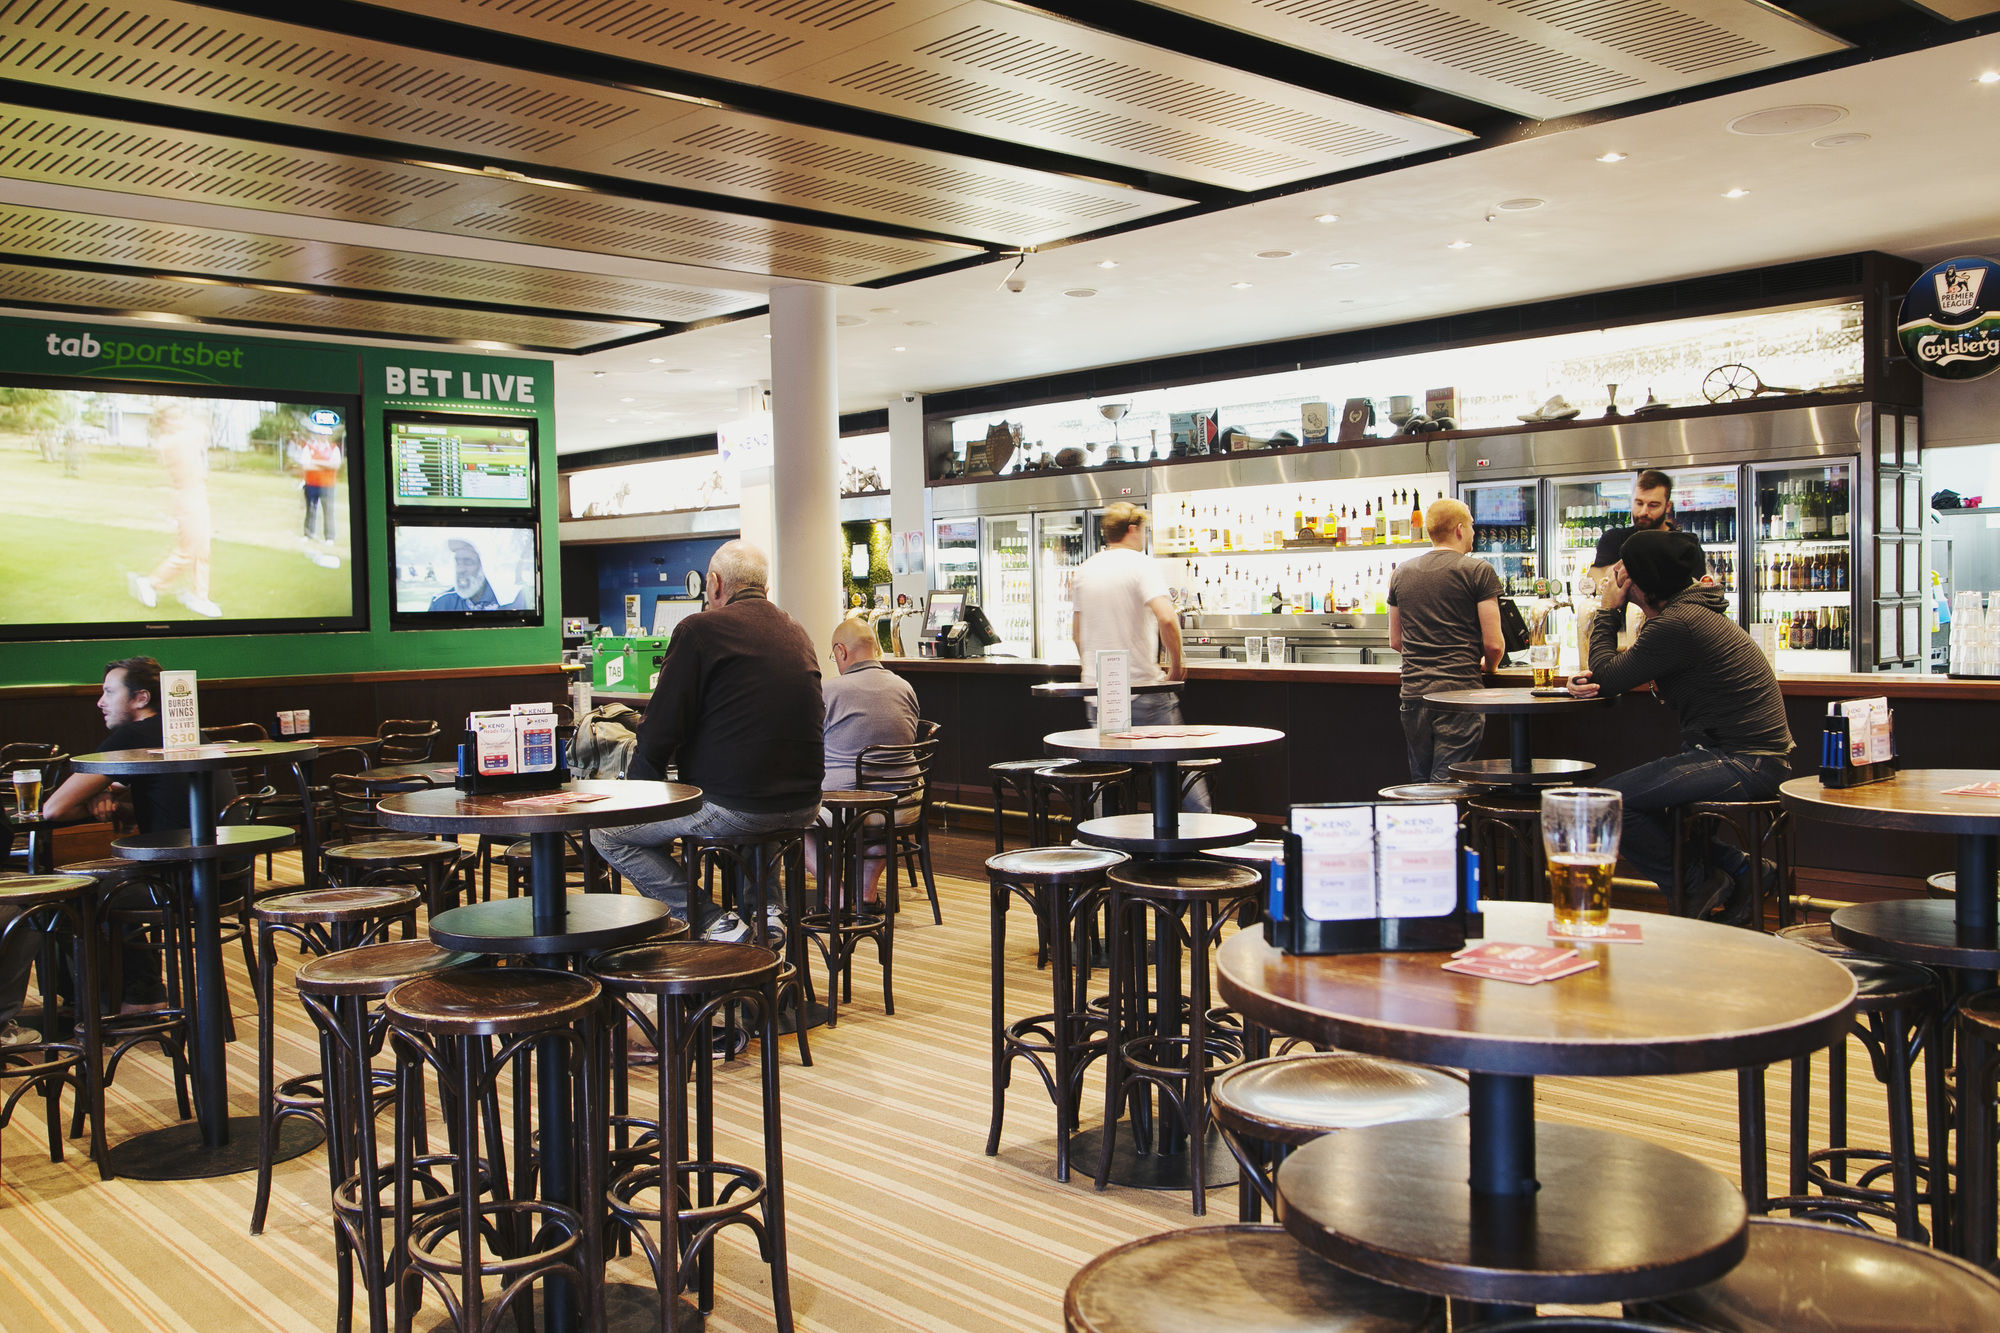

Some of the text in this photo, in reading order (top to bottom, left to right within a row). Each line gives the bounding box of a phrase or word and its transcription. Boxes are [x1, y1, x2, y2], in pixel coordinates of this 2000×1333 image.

[1941, 292, 1974, 301] PREMIER
[1942, 299, 1972, 309] LEAGUE
[1917, 332, 2000, 364] Carlsberg
[385, 366, 535, 403] BET LIVE
[1199, 416, 1208, 453] SPALDING
[608, 666, 622, 678] TAB
[168, 699, 194, 708] BURGER
[169, 707, 194, 717] WINGS
[170, 732, 196, 745] $30
[1321, 820, 1351, 829] KENO
[1404, 818, 1434, 826] KENO
[1320, 879, 1345, 887] Evens
[1402, 876, 1427, 884] Evens
